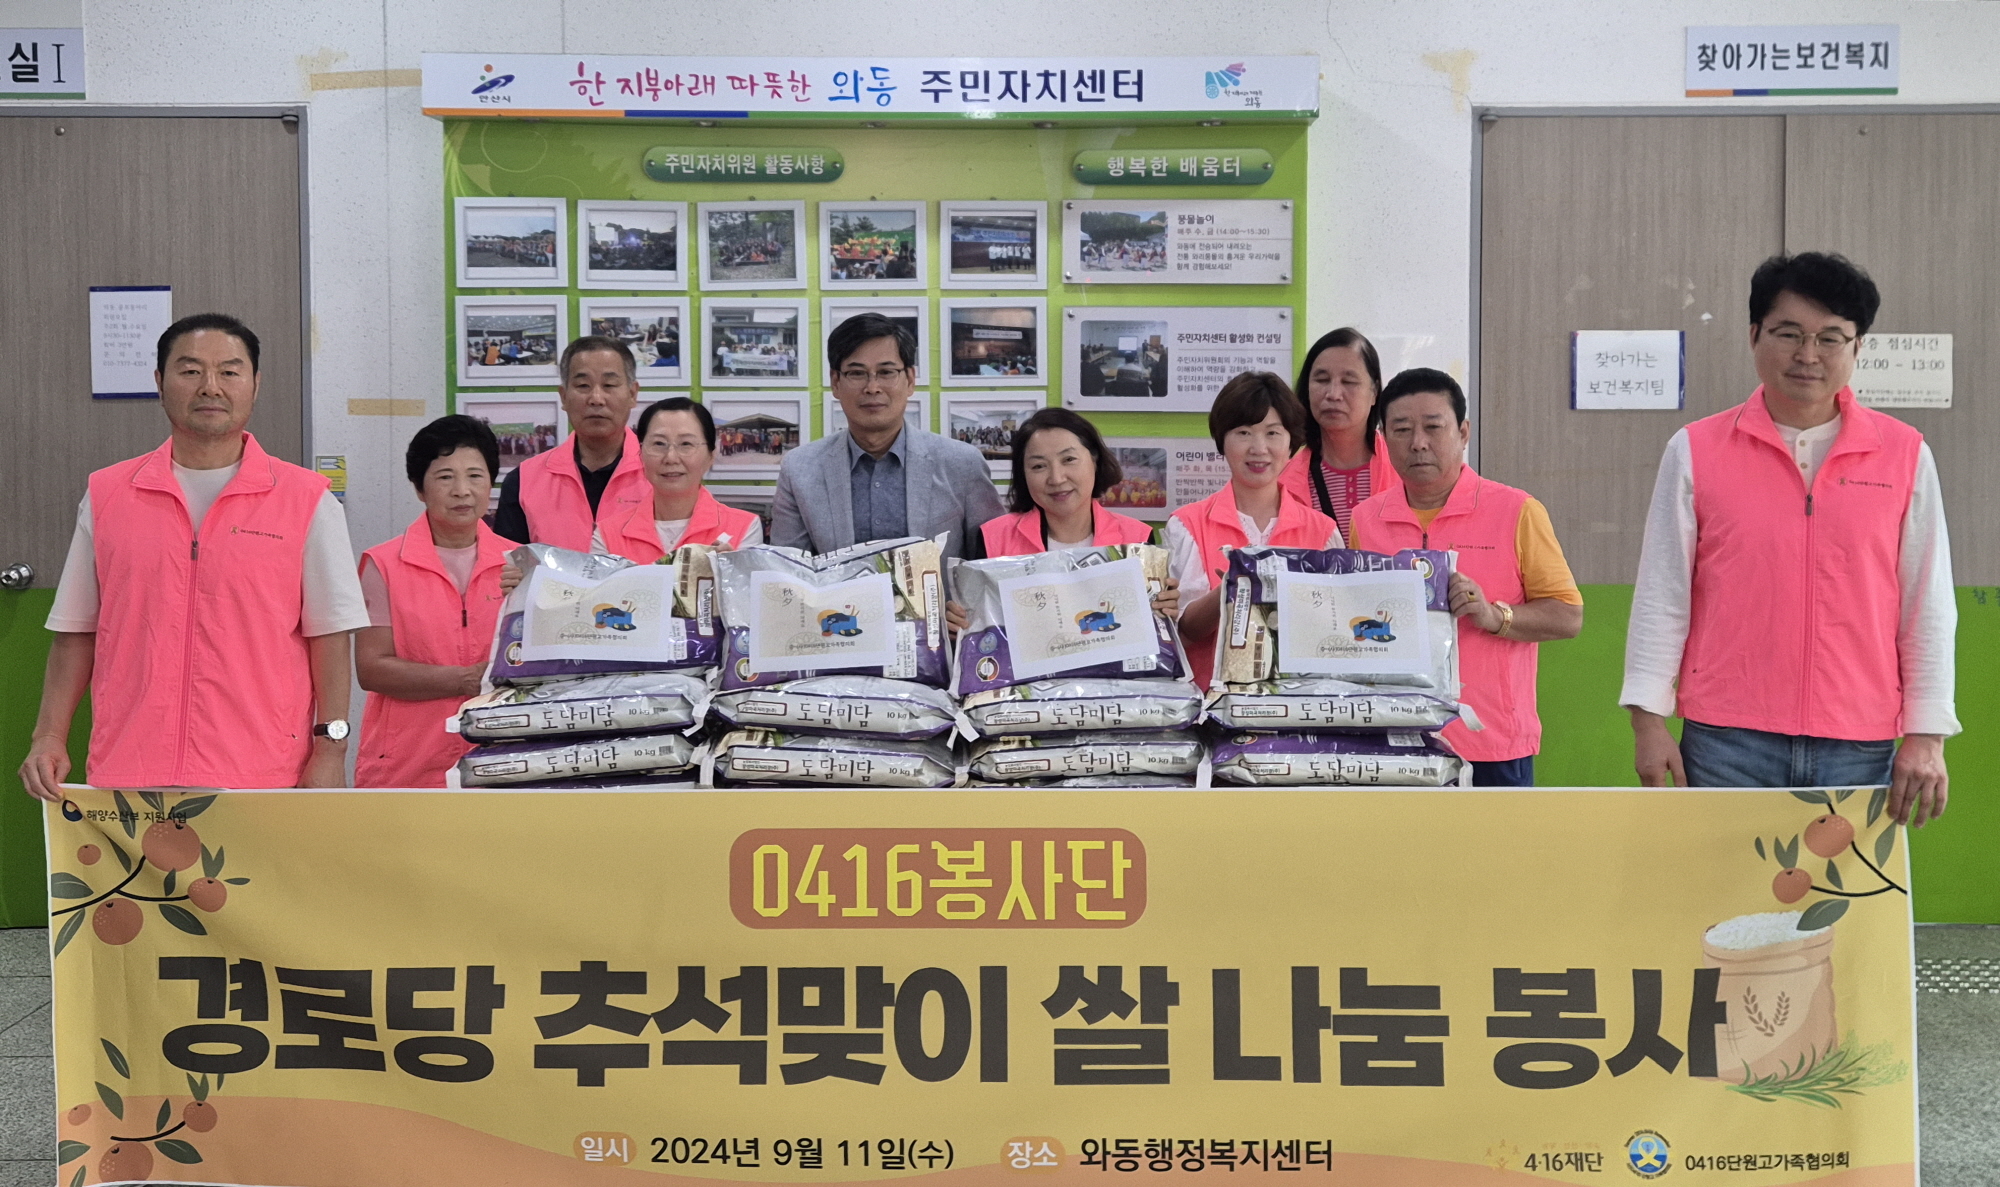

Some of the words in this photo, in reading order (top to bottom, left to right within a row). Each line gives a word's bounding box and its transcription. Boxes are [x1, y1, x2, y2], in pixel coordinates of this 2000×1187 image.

[8, 42, 39, 83] 실
[1697, 41, 1890, 72] 찾아가는보건복지
[569, 61, 606, 106] 한
[617, 67, 715, 102] 지붕아래
[726, 68, 812, 102] 따뜻한
[828, 66, 898, 107] 와동
[920, 68, 1144, 104] 주민자치센터
[1245, 97, 1261, 108] 와동
[665, 153, 756, 175] 주민자치위원
[764, 153, 826, 175] 활동사항
[1107, 156, 1169, 178] 행복한
[1180, 156, 1241, 178] 배움터
[1177, 333, 1227, 343] 주민자치센터
[1229, 333, 1254, 344] 활성화
[1257, 333, 1282, 344] 컨설팅
[1595, 350, 1659, 370] 찾아가는
[1856, 358, 1889, 370] 12:00
[1912, 359, 1945, 370] 13:00
[1586, 379, 1665, 396] 보건복지팀
[1176, 451, 1203, 461] 어린이
[541, 705, 615, 730] 도담미담
[628, 708, 637, 716] 10
[797, 703, 873, 728] 도담미담
[886, 711, 895, 719] 10
[1050, 703, 1125, 728] 도담미담
[1299, 701, 1376, 724] 도담미담
[1390, 705, 1399, 713] 10
[546, 746, 620, 774] 도담미담
[634, 749, 643, 757] 10
[799, 757, 875, 782] 도담미담
[889, 767, 898, 775] 10
[1061, 751, 1134, 773] 도담미담
[1148, 756, 1157, 764] 10
[1307, 758, 1384, 781] 도담미담
[86, 809, 140, 823] 해양수산부
[143, 810, 187, 824] 지원사업
[753, 839, 1132, 921] 0416봉사단
[158, 956, 506, 1082] 경로당
[533, 960, 1009, 1087] 추석맞이
[1040, 965, 1179, 1085] 쌀
[1211, 965, 1450, 1086] 나눔
[1486, 966, 1728, 1089] 봉사
[580, 1136, 629, 1163] 일시
[650, 1136, 760, 1168] 2024년
[773, 1137, 824, 1169] 9월
[837, 1138, 954, 1170] 11일(수)
[1007, 1140, 1059, 1170] 장소
[1079, 1137, 1333, 1172] 와동행정복지센터
[1685, 1150, 1850, 1172] 0416단원고가족협의회
